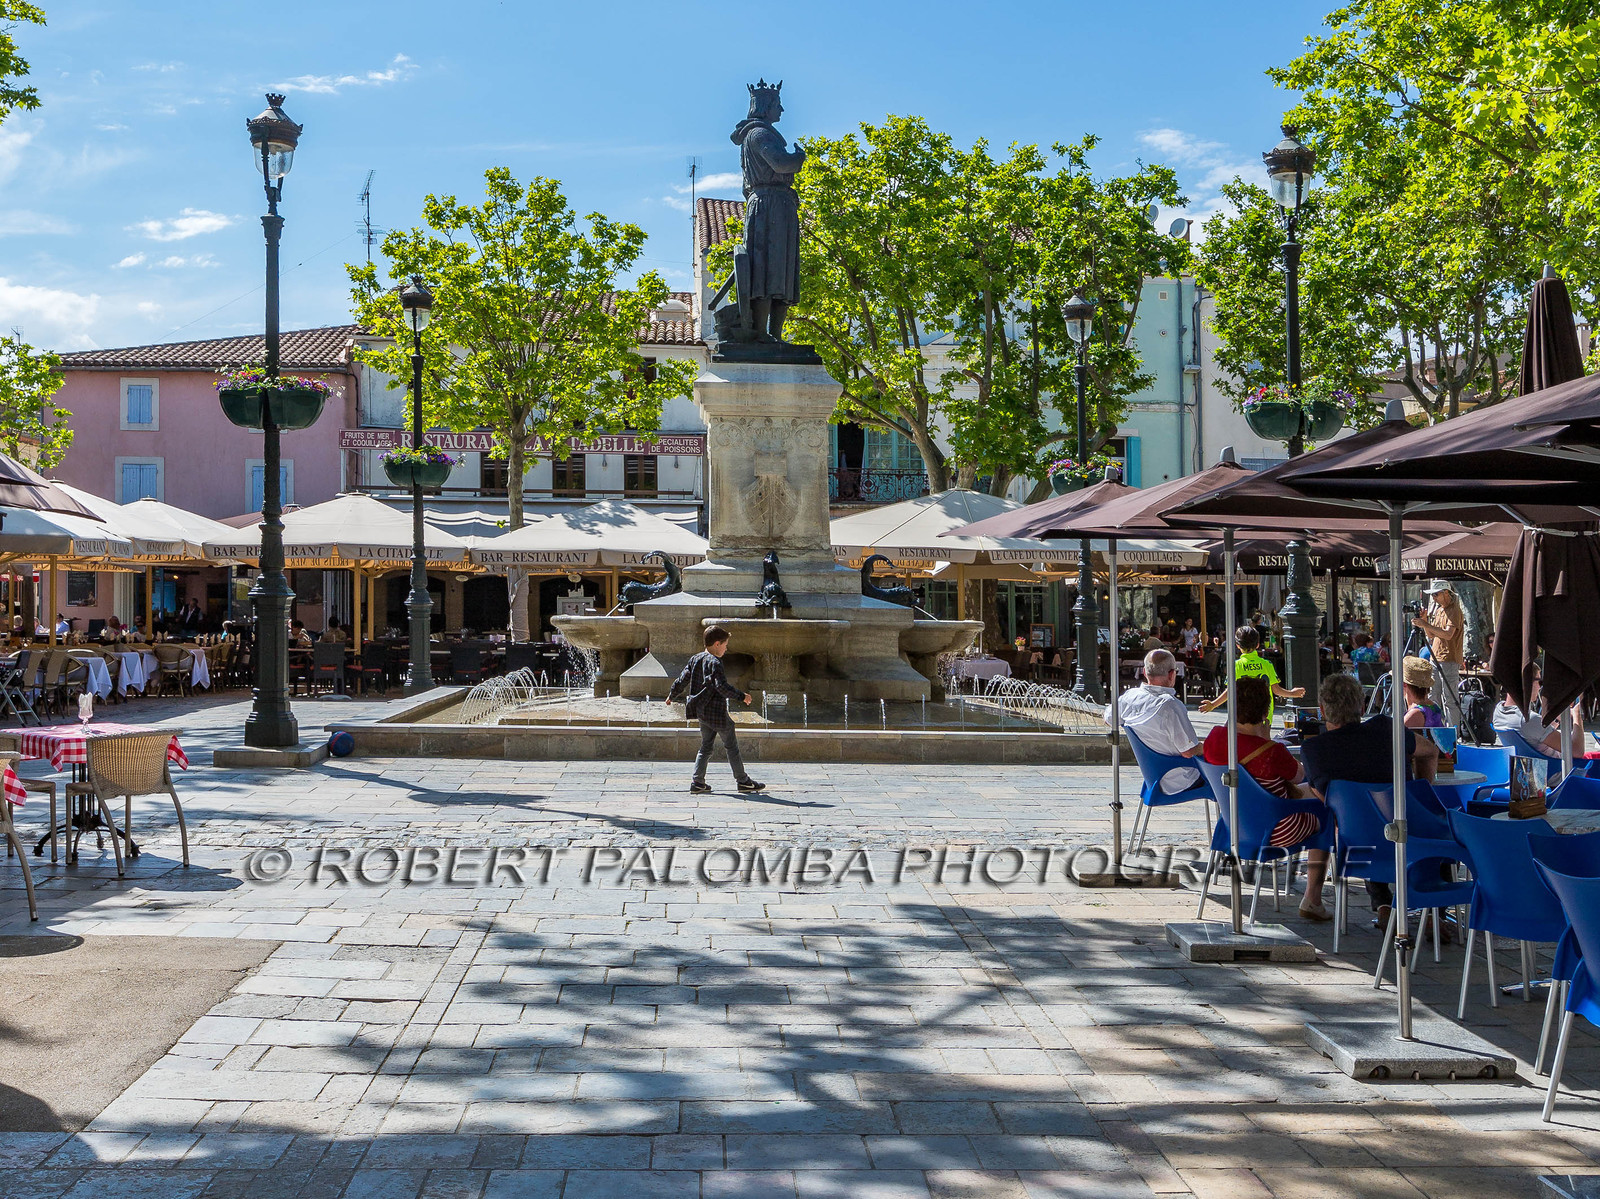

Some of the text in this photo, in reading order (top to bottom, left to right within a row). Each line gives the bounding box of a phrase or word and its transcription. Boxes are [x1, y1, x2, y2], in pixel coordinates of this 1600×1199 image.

[344, 431, 390, 440] FRUITS DE MER
[352, 439, 393, 447] COQUILLAGES
[400, 433, 503, 449] RSTAURAN
[654, 438, 699, 446] PECIALITES
[651, 445, 661, 453] DE
[359, 547, 374, 557] LA
[898, 548, 952, 559] RESTAURANT
[990, 550, 1080, 561] LE CAFE DU COMMER
[1123, 551, 1184, 563] COQUILLAGES
[622, 553, 638, 564] LA
[1435, 558, 1493, 571] RESTAURANT
[1243, 662, 1263, 671] MESSI
